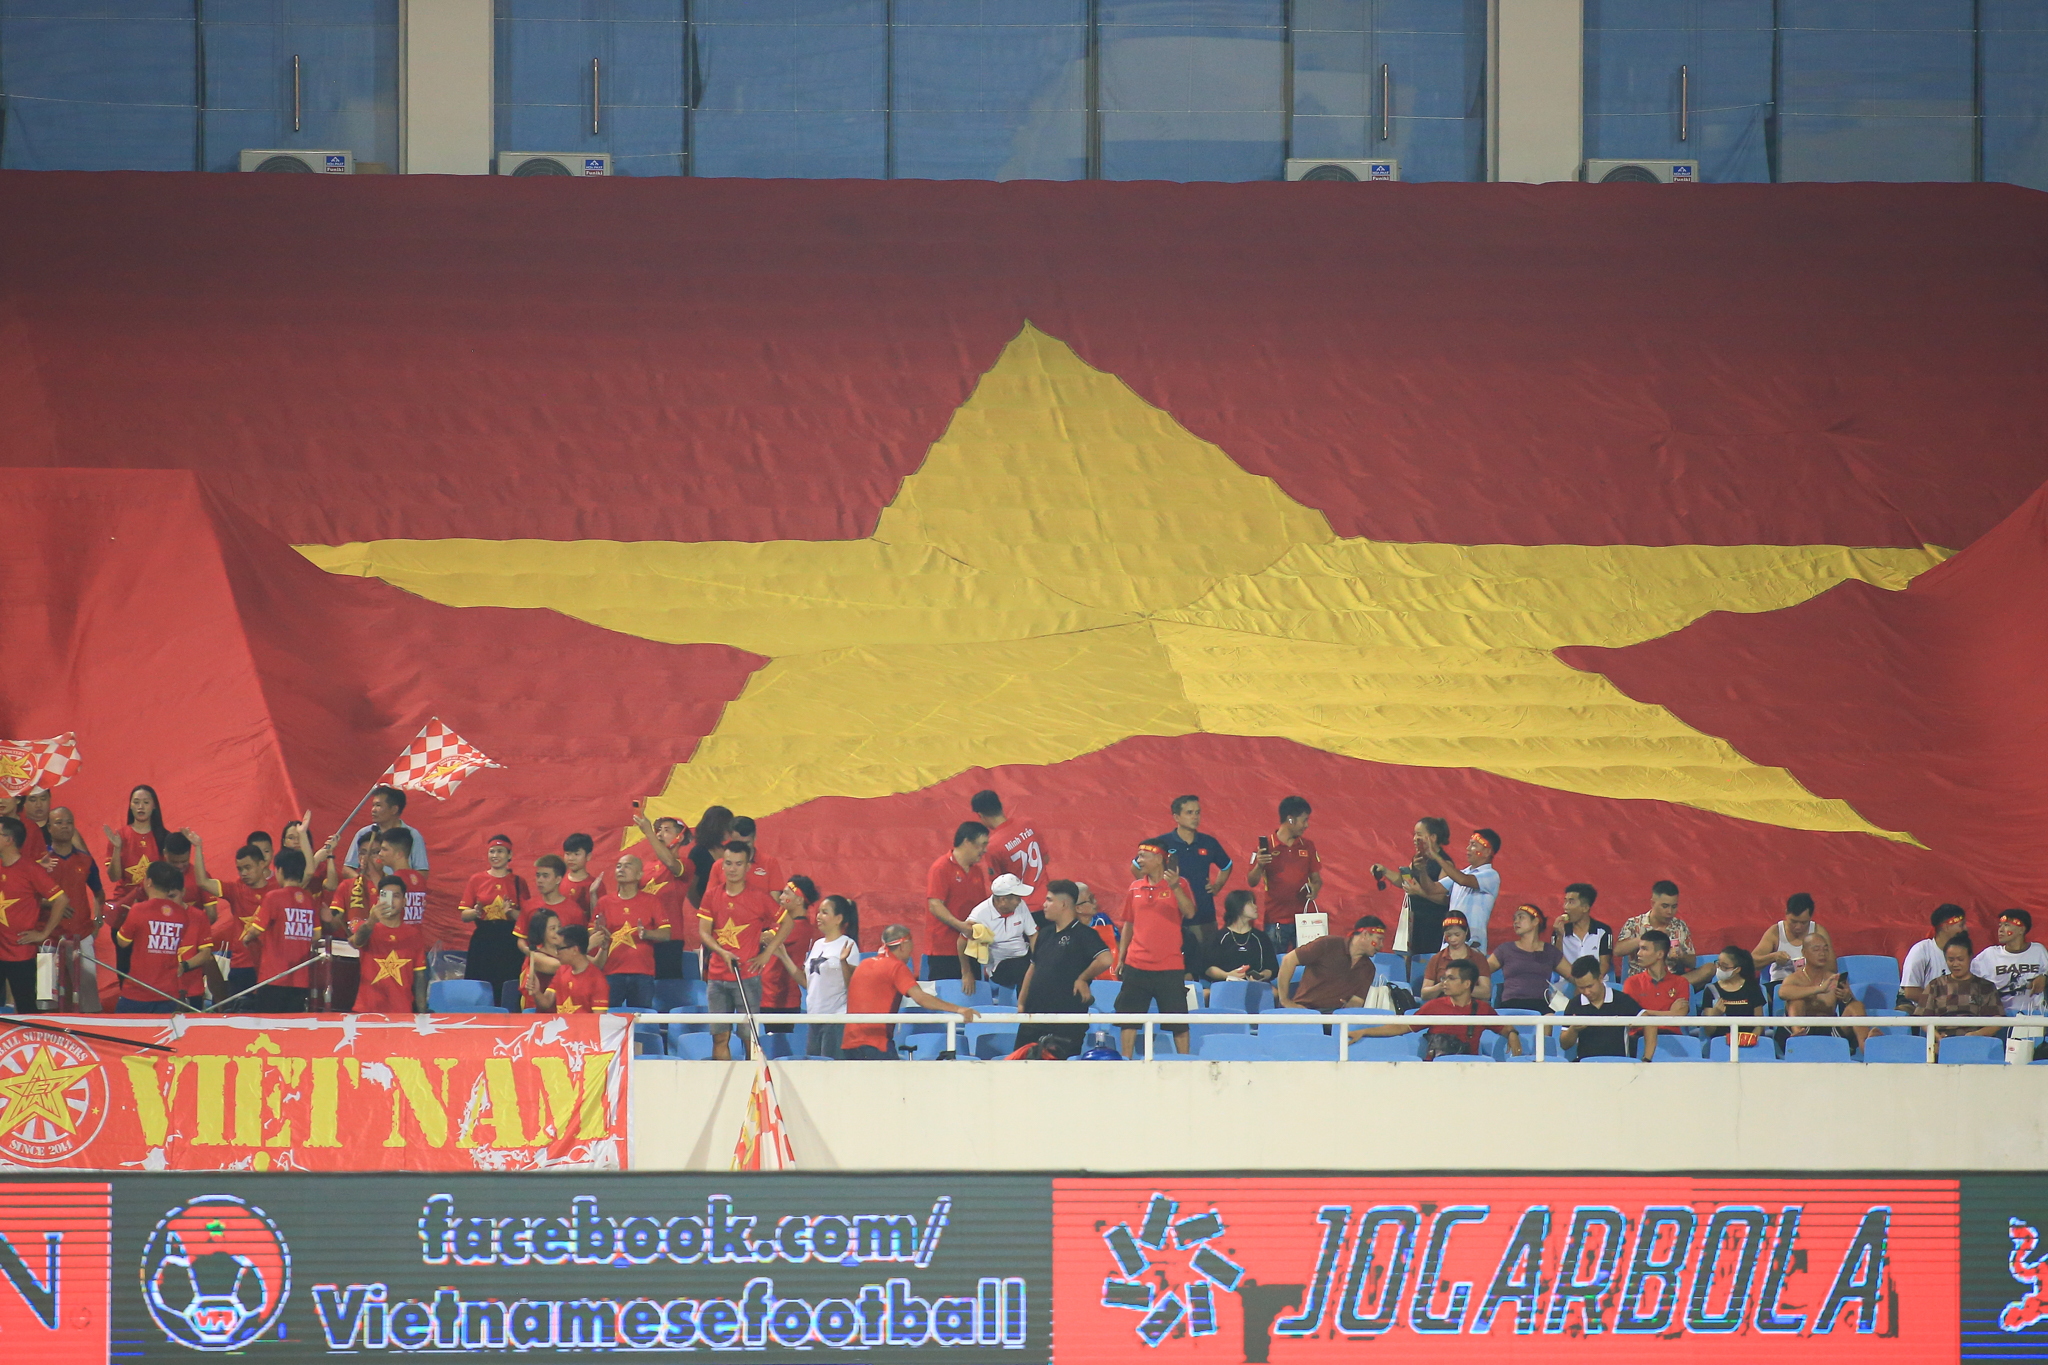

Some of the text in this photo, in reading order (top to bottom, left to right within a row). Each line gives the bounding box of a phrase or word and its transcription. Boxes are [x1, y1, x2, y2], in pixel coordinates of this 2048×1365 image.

[1010, 841, 1043, 883] 79
[284, 907, 314, 924] VIET
[148, 920, 184, 937] VIET
[284, 921, 314, 937] NAM
[147, 935, 180, 951] NAM
[1995, 963, 2041, 976] BABE
[22, 1031, 88, 1062] SUPPORTERS
[382, 1050, 617, 1149] NAM
[9, 1139, 73, 1156] SINCE 2014
[418, 1193, 952, 1268] facebook.com/
[1273, 1204, 1892, 1335] JOGARBOLA
[311, 1277, 1026, 1350] Vietnamesefootball
